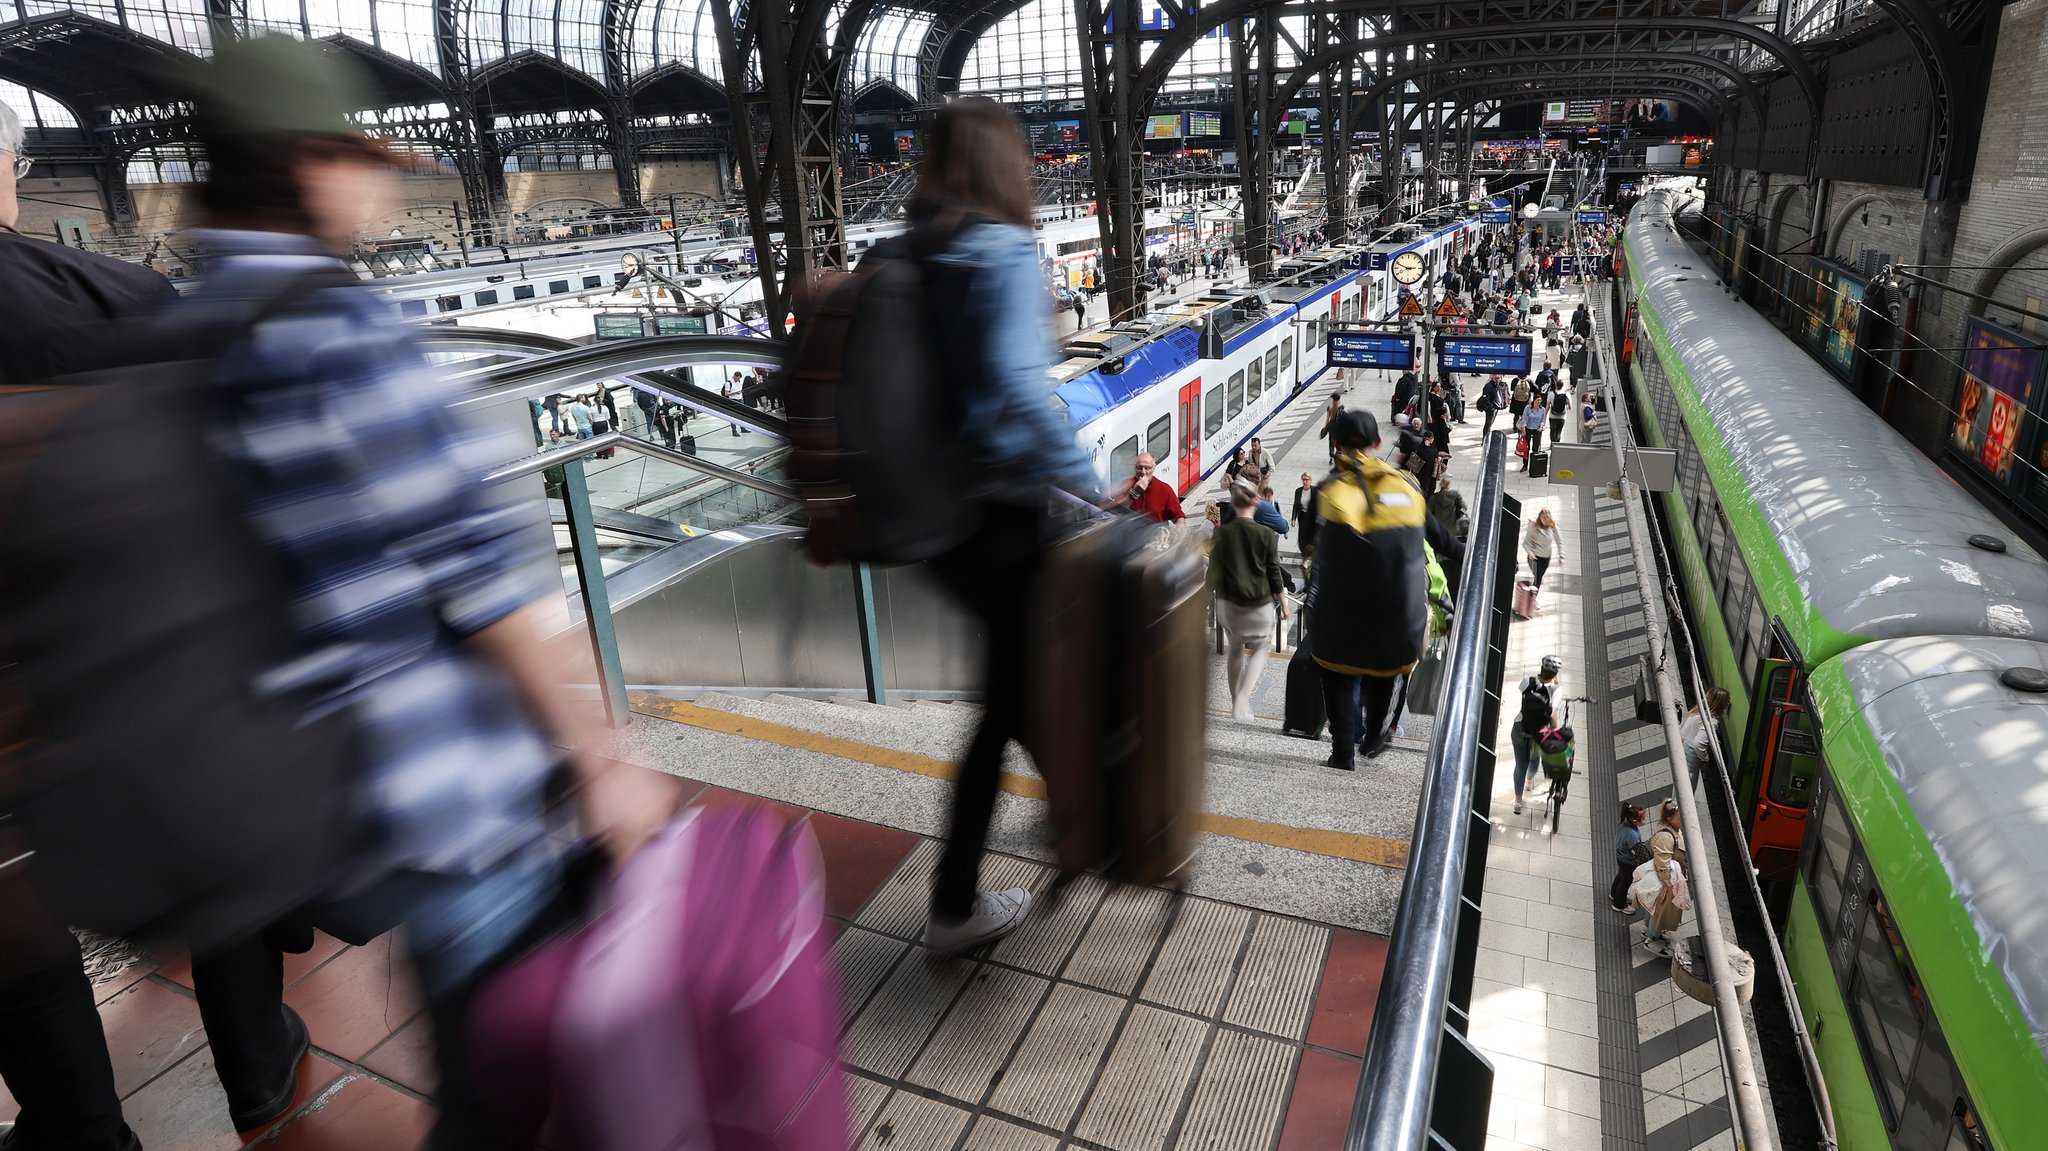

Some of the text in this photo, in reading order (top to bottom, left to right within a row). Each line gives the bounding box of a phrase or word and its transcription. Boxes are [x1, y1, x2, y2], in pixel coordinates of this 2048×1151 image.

[745, 249, 752, 260] E
[1350, 254, 1379, 267] 13 E
[1560, 257, 1598, 272] E 14
[1333, 338, 1342, 347] 13
[1510, 344, 1521, 353] 14
